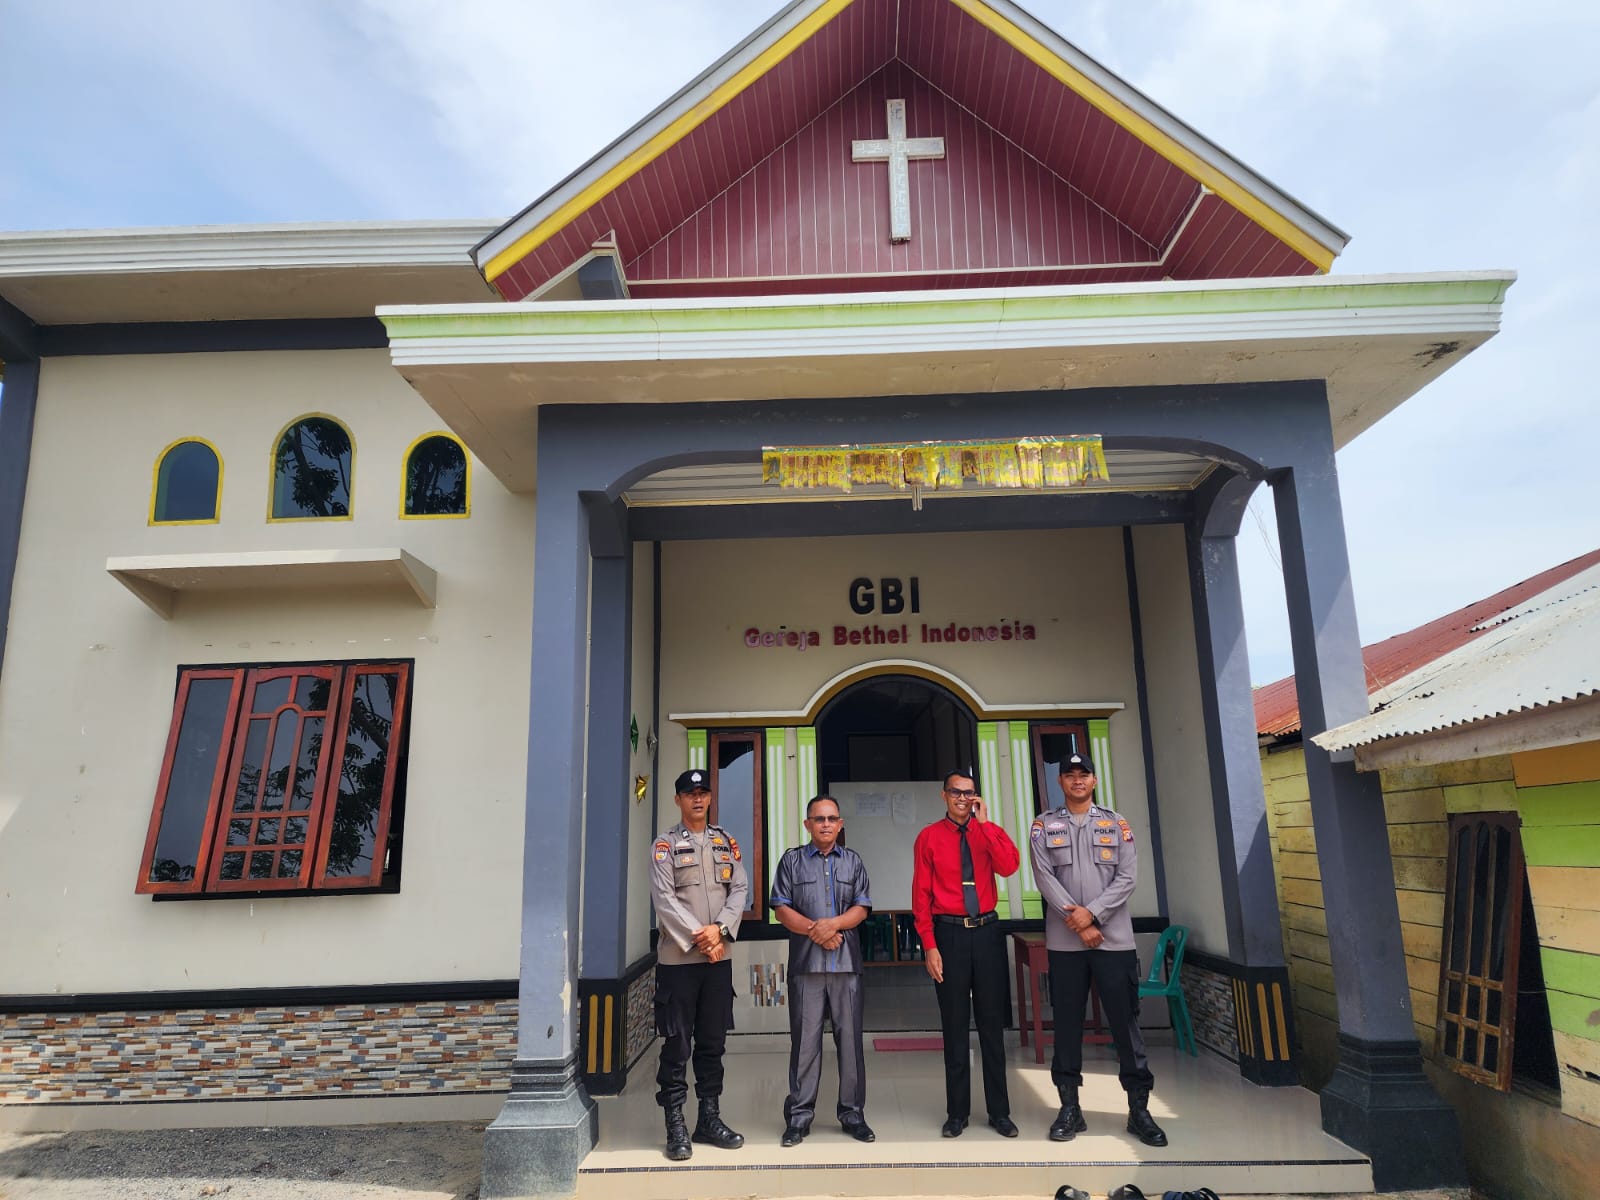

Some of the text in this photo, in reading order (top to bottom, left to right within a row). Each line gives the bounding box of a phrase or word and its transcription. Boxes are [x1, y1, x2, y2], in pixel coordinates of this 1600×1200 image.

[849, 576, 920, 615] GBI
[744, 620, 1036, 651] Gereja Bethel Indonesia
